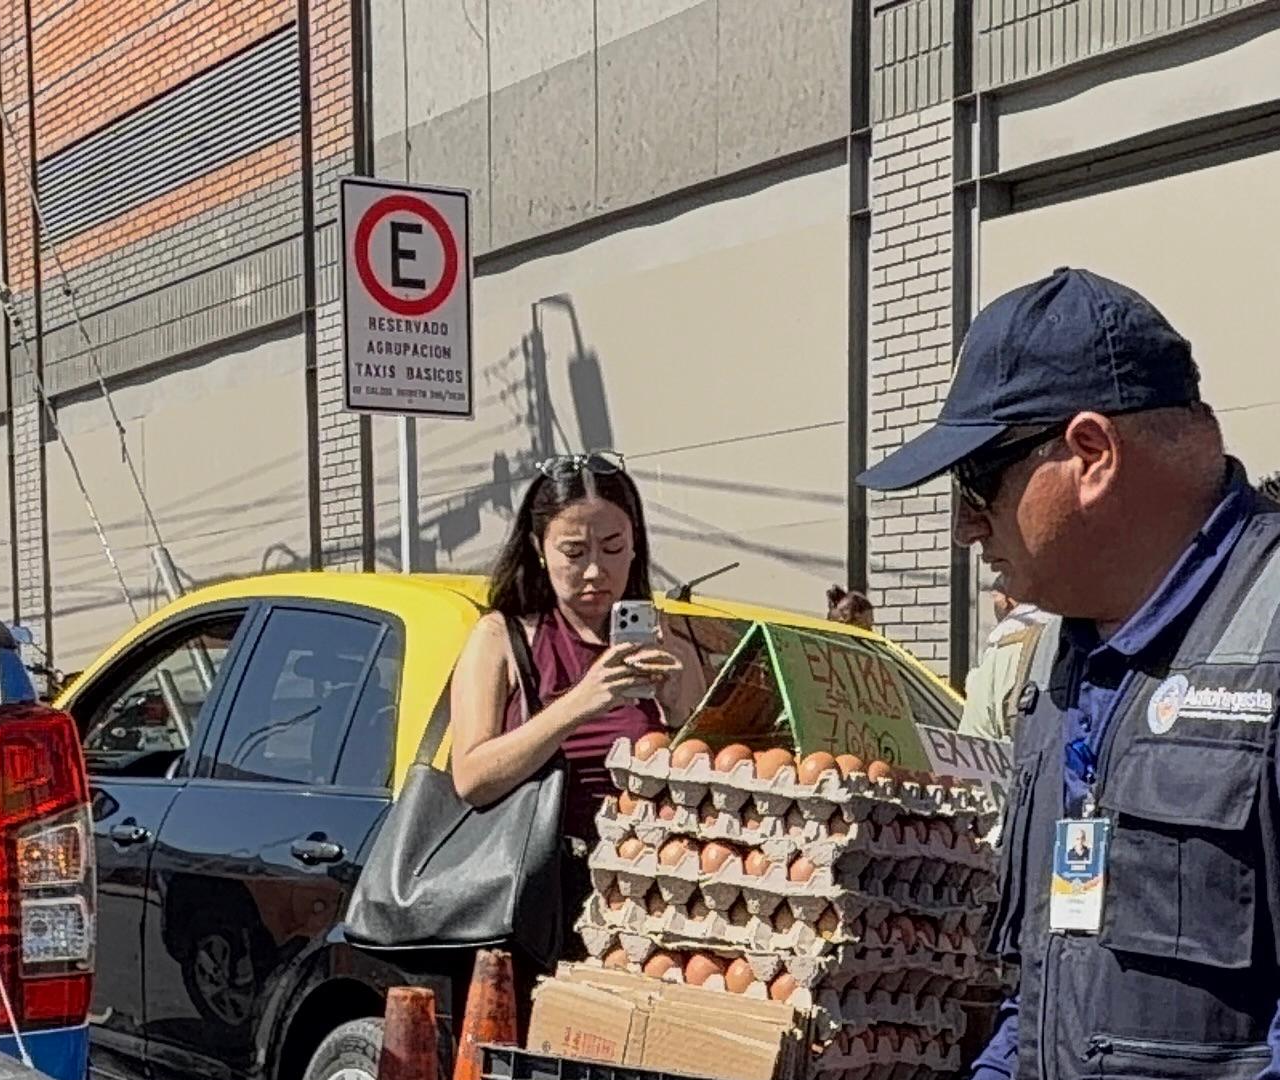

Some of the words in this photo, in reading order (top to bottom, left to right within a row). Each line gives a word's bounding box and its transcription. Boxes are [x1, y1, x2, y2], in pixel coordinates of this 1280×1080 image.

[390, 221, 426, 290] E
[368, 316, 449, 336] RESERVADO
[367, 340, 452, 360] AGRUPACION
[355, 362, 396, 379] TAXIS
[406, 366, 464, 384] BASICOS
[800, 635, 905, 707] EXTRA
[923, 727, 1012, 779] EXTRA
